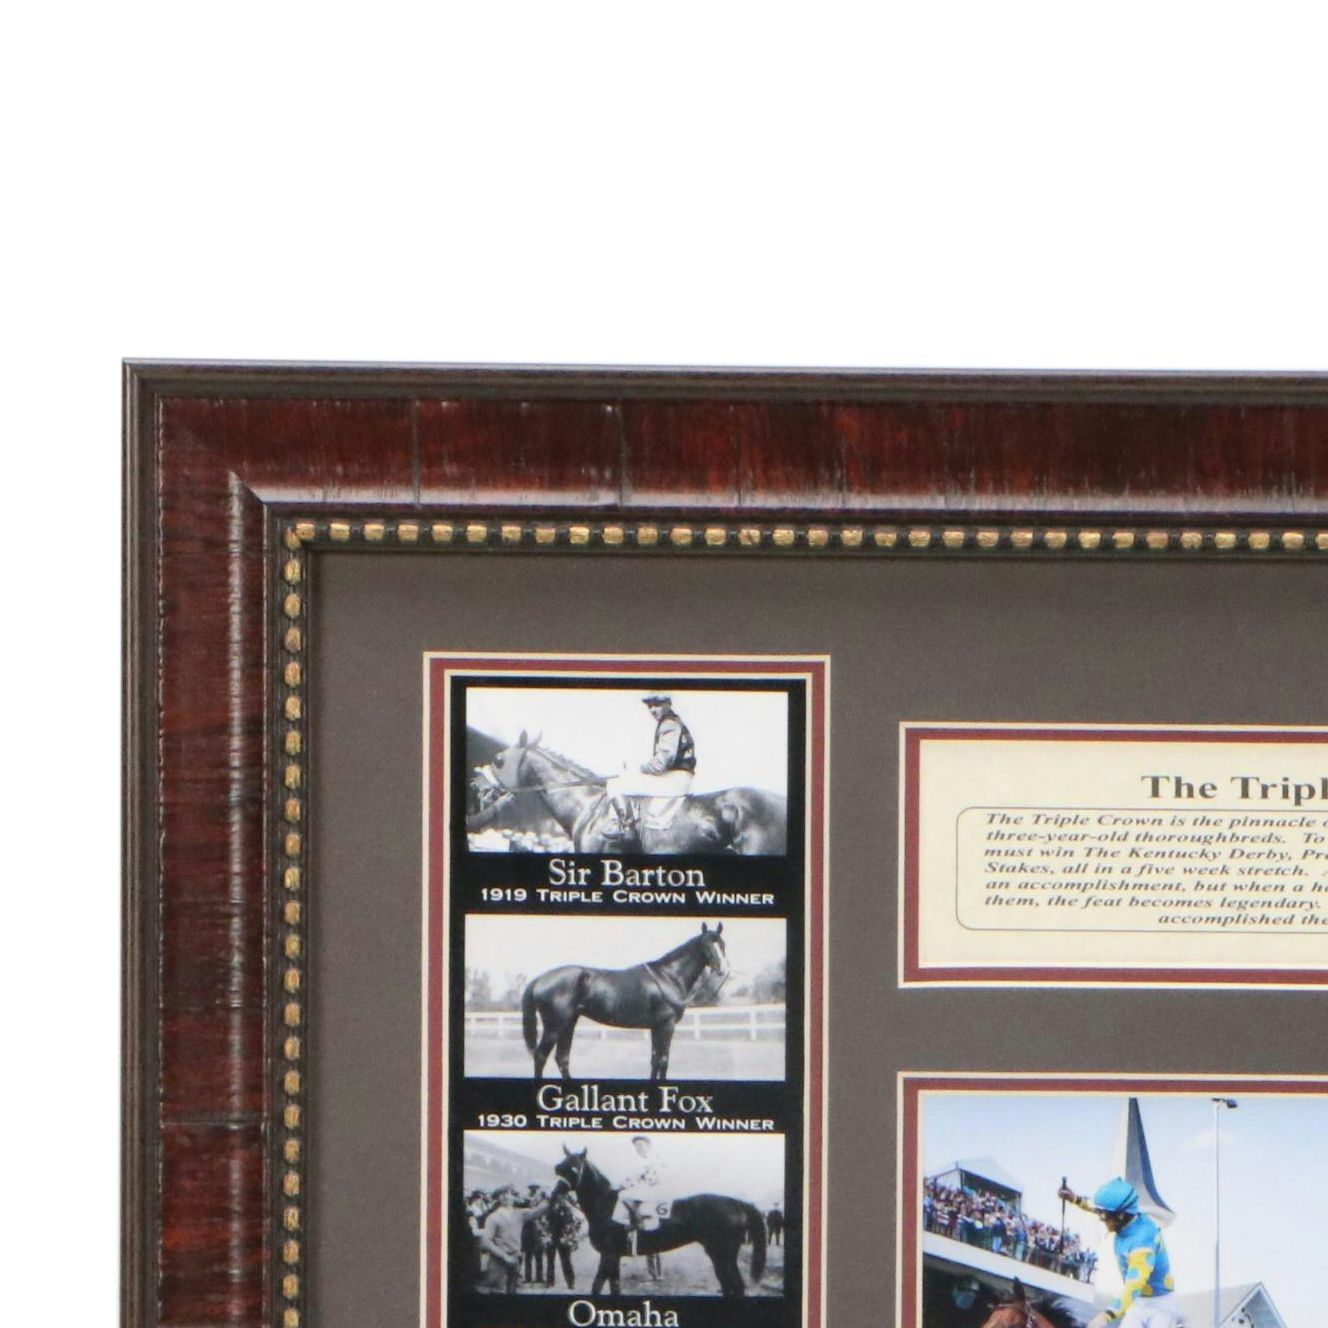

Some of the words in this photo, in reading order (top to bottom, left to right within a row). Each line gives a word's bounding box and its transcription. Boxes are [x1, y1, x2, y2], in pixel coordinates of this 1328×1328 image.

[1141, 775, 1217, 799] The
[988, 813, 1023, 825] The
[1033, 813, 1090, 828] Triple
[1097, 815, 1163, 826] Crown
[1170, 815, 1185, 826] is
[1192, 815, 1223, 826] the
[1228, 815, 1316, 830] pinnacle
[986, 829, 1129, 844] three-year-old
[1134, 831, 1285, 845] thoroughbreds.
[1303, 832, 1325, 844] To
[549, 858, 591, 885] Sir
[600, 859, 705, 887] Barton
[481, 888, 527, 902] 1919
[1158, 913, 1295, 927] accomplished
[536, 1084, 649, 1112] Gallant
[658, 1086, 713, 1113] Fox
[478, 1113, 527, 1127] 1930
[656, 1202, 669, 1216] 6
[568, 1299, 679, 1327] Omaha
